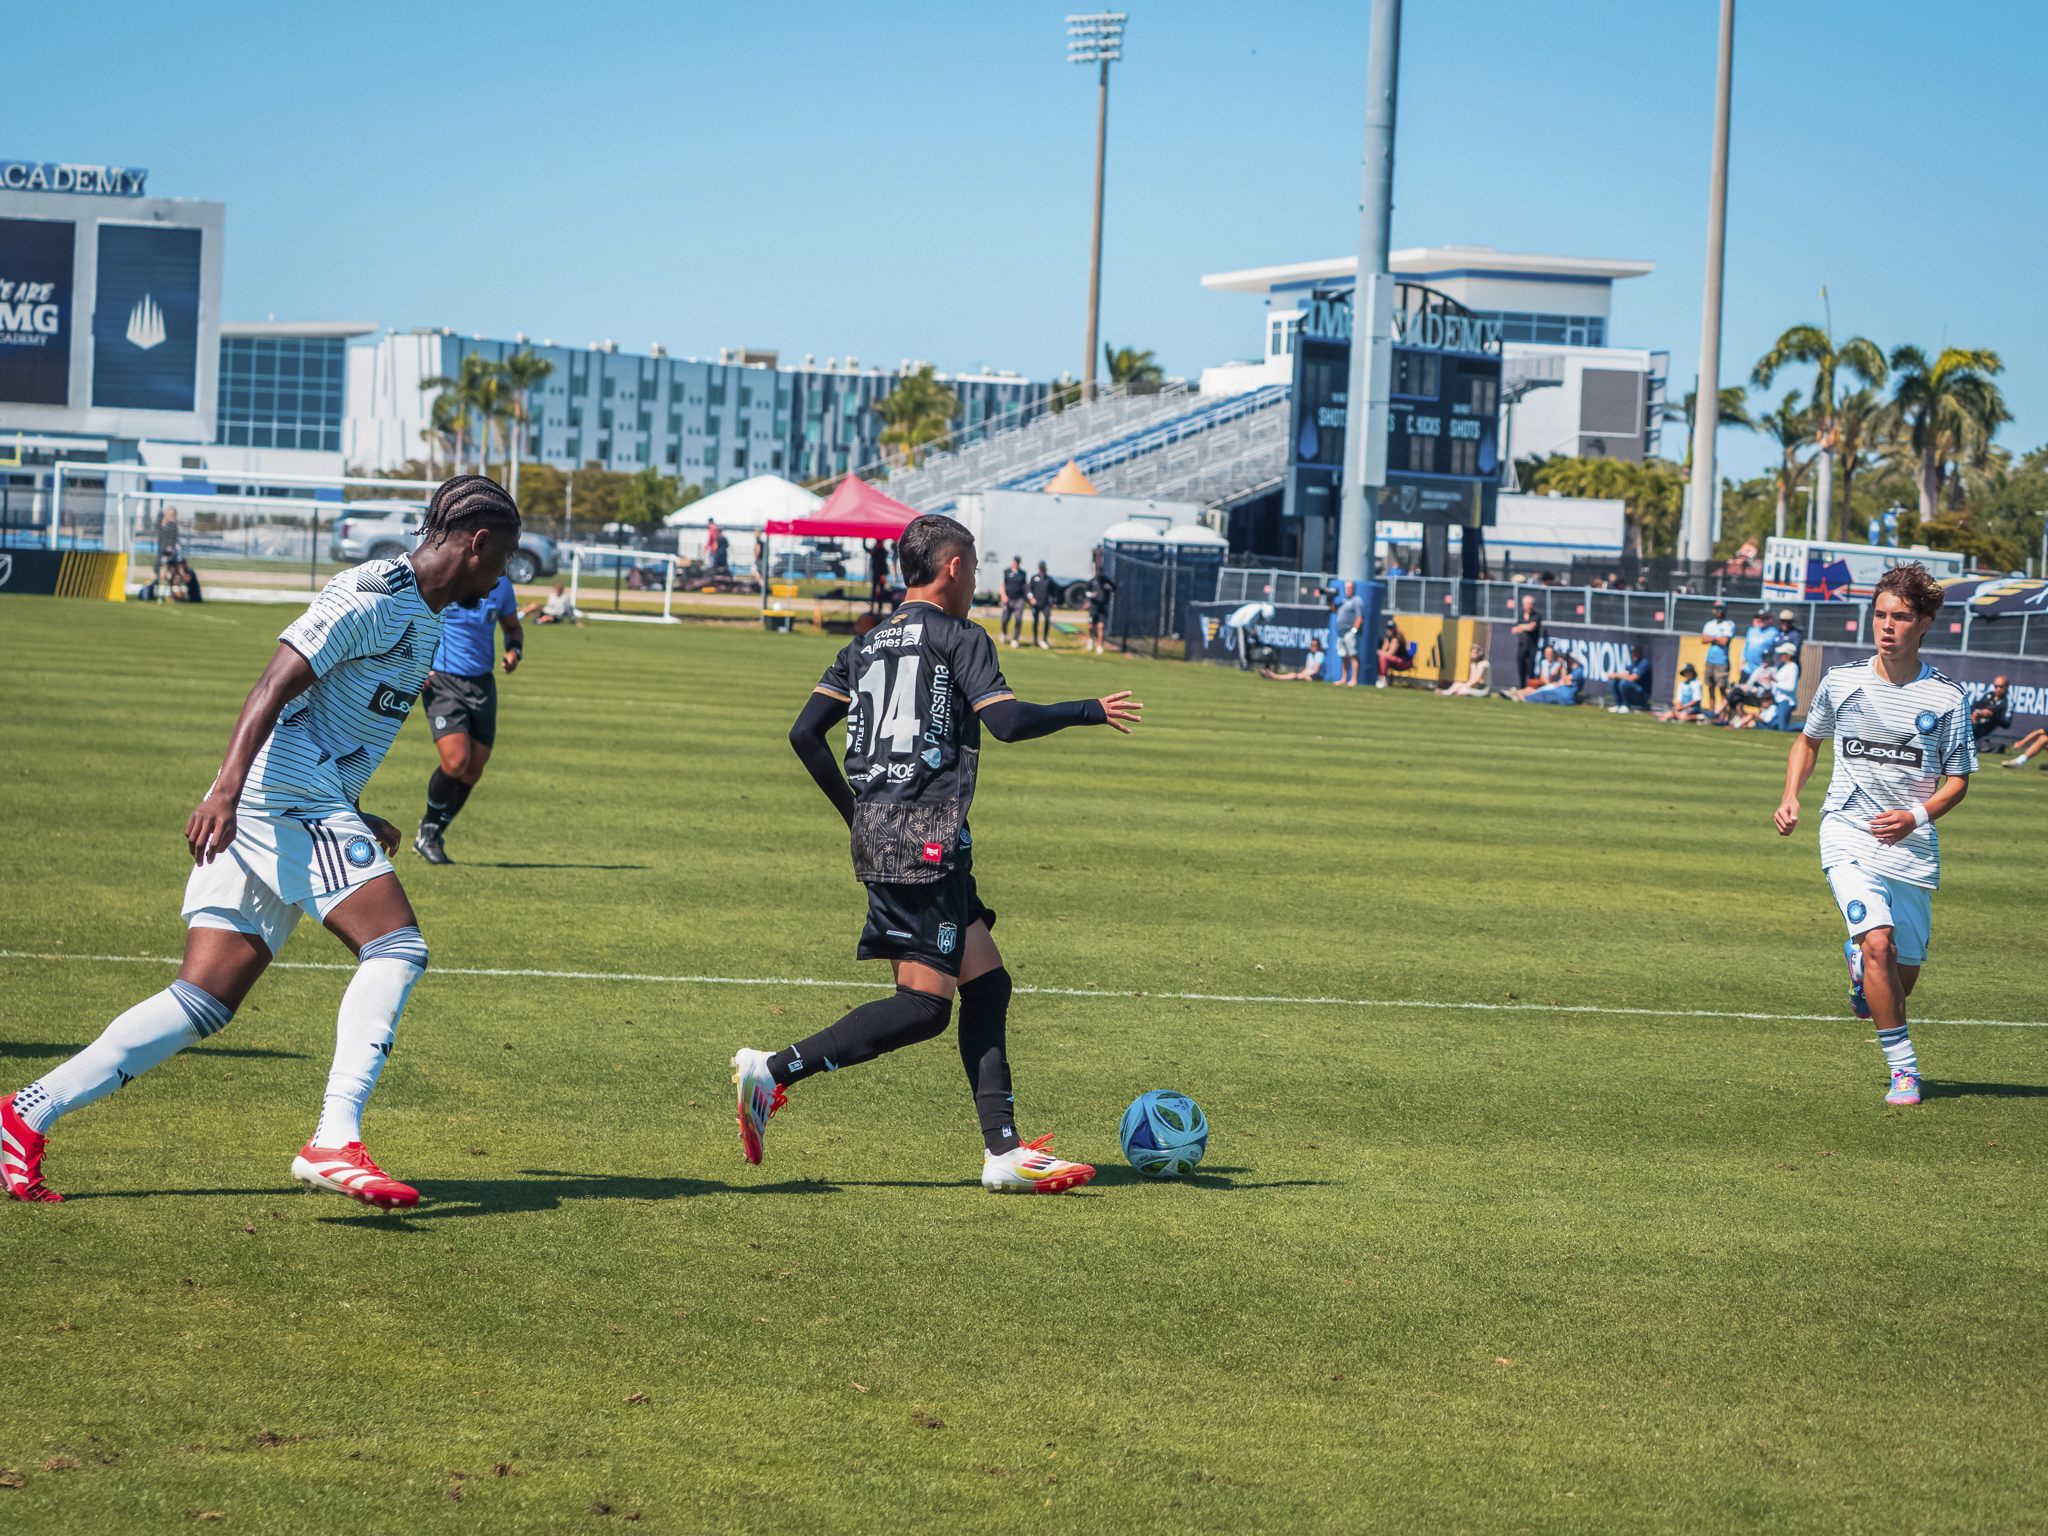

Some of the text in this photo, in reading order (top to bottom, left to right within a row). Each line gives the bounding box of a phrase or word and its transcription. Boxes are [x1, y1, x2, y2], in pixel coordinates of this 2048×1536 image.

[1393, 307, 1501, 355] ADEMY
[1449, 418, 1481, 440] SHOTS
[858, 655, 920, 757] 14
[1862, 745, 1917, 762] LEXUS
[887, 762, 916, 779] KOE
